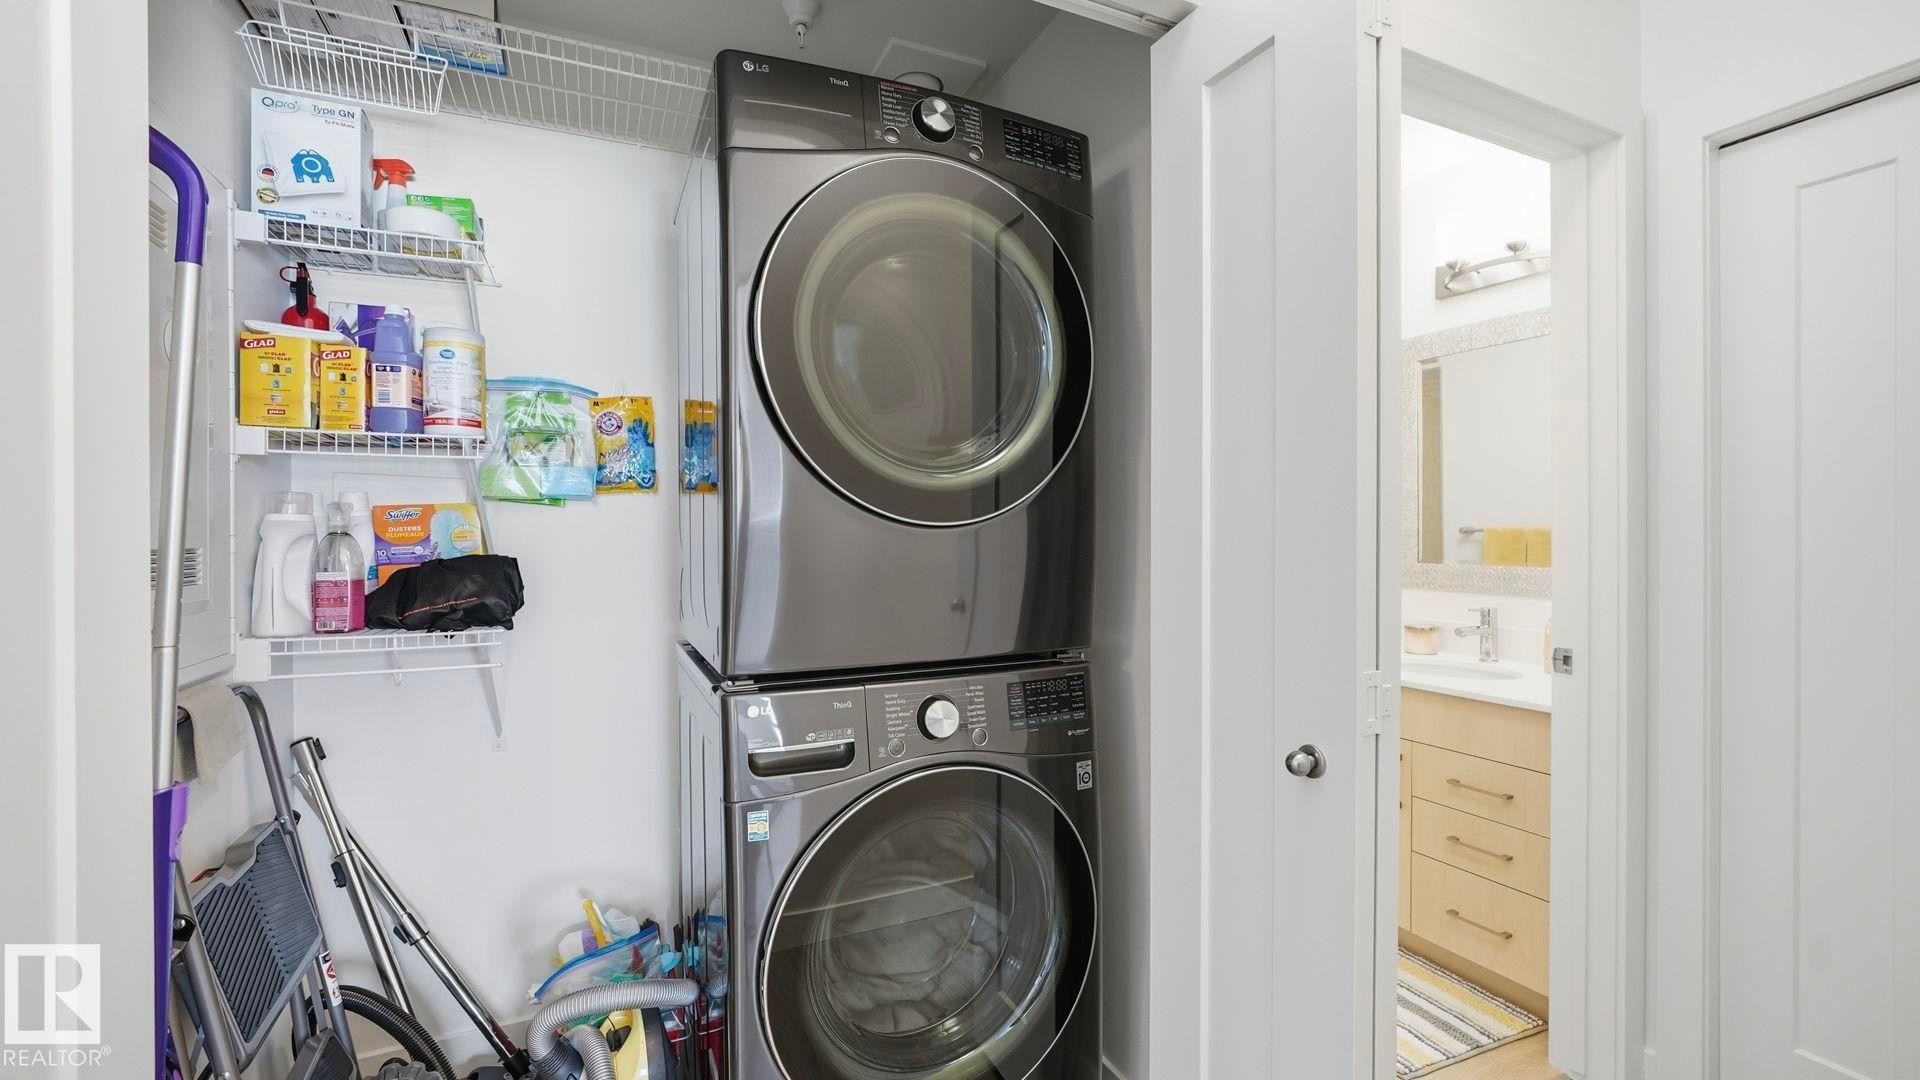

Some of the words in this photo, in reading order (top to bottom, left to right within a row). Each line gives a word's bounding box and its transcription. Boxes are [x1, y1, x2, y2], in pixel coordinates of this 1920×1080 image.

[756, 63, 770, 73] LG
[829, 77, 849, 87] ThinQ
[312, 104, 336, 115] Type
[338, 109, 355, 119] GN
[244, 339, 275, 349] GLAD
[322, 350, 351, 360] GLAD
[384, 508, 422, 521] Swiffer
[376, 549, 387, 557] 10
[832, 701, 853, 710] ThinQ
[1078, 771, 1091, 785] 10
